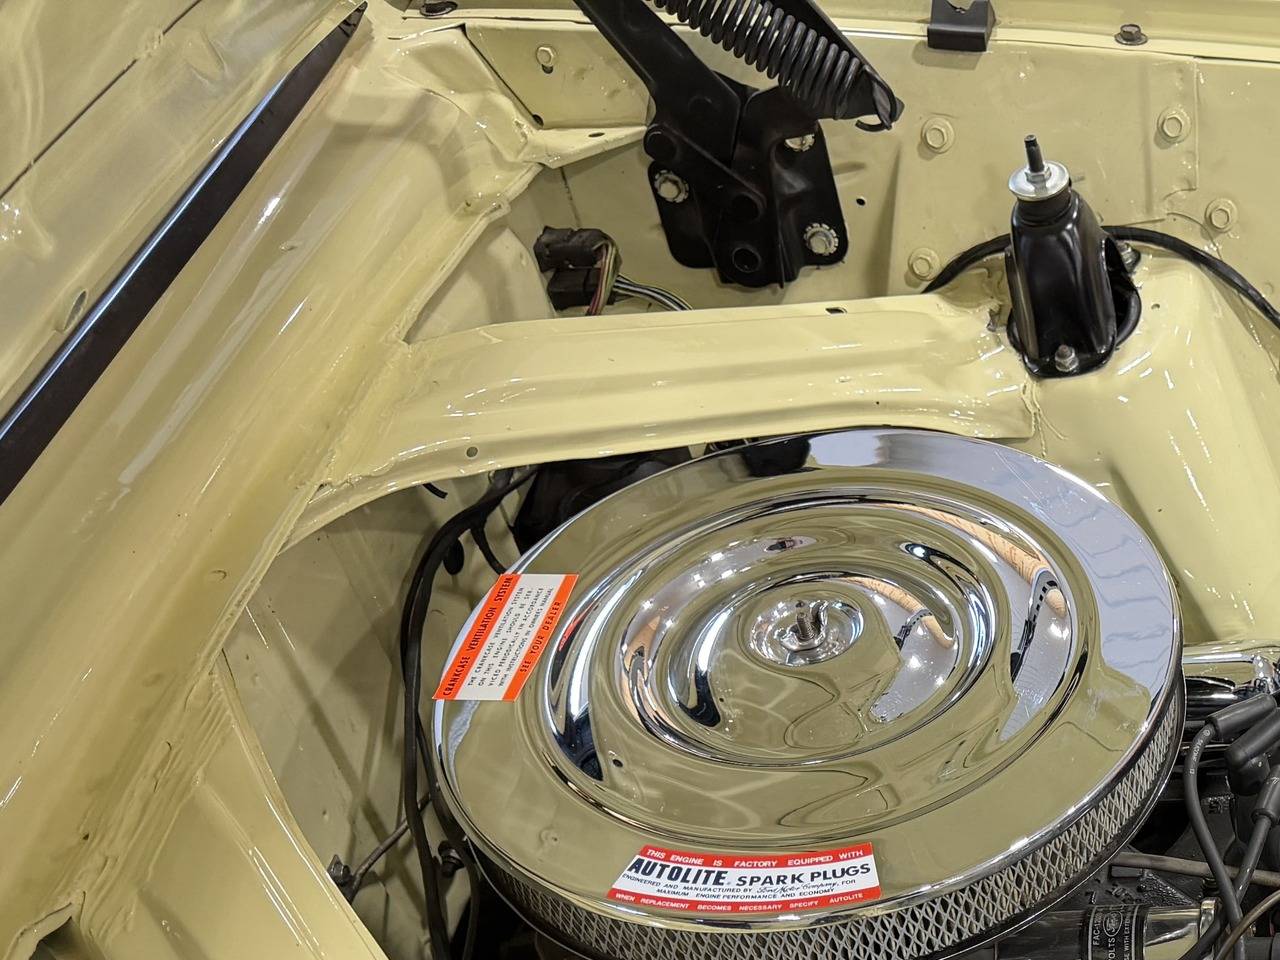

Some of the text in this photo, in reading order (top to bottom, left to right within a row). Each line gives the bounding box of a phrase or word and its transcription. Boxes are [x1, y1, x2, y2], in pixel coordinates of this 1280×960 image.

[443, 577, 513, 696] CRANKCASE VENTILATION SYSTEM
[520, 601, 561, 673] SEE YOUR DEALER
[647, 849, 666, 859] THIS
[670, 855, 705, 866] ENGINE
[734, 860, 778, 868] FACTORY
[788, 855, 834, 866] EQUIPPED
[839, 850, 864, 860] WITH
[622, 873, 661, 887] ENGINEERED
[627, 858, 871, 887] AUTOLITE SPARK PLUGS
[656, 889, 690, 897] MAXIMUM
[800, 888, 835, 897] ECONOMY
[615, 893, 636, 902] WHEN
[641, 898, 691, 909] REPLACEMENT
[739, 904, 782, 912] NECESSARY
[789, 900, 819, 909] SPECIFY
[829, 893, 864, 904] AUTOLITE
